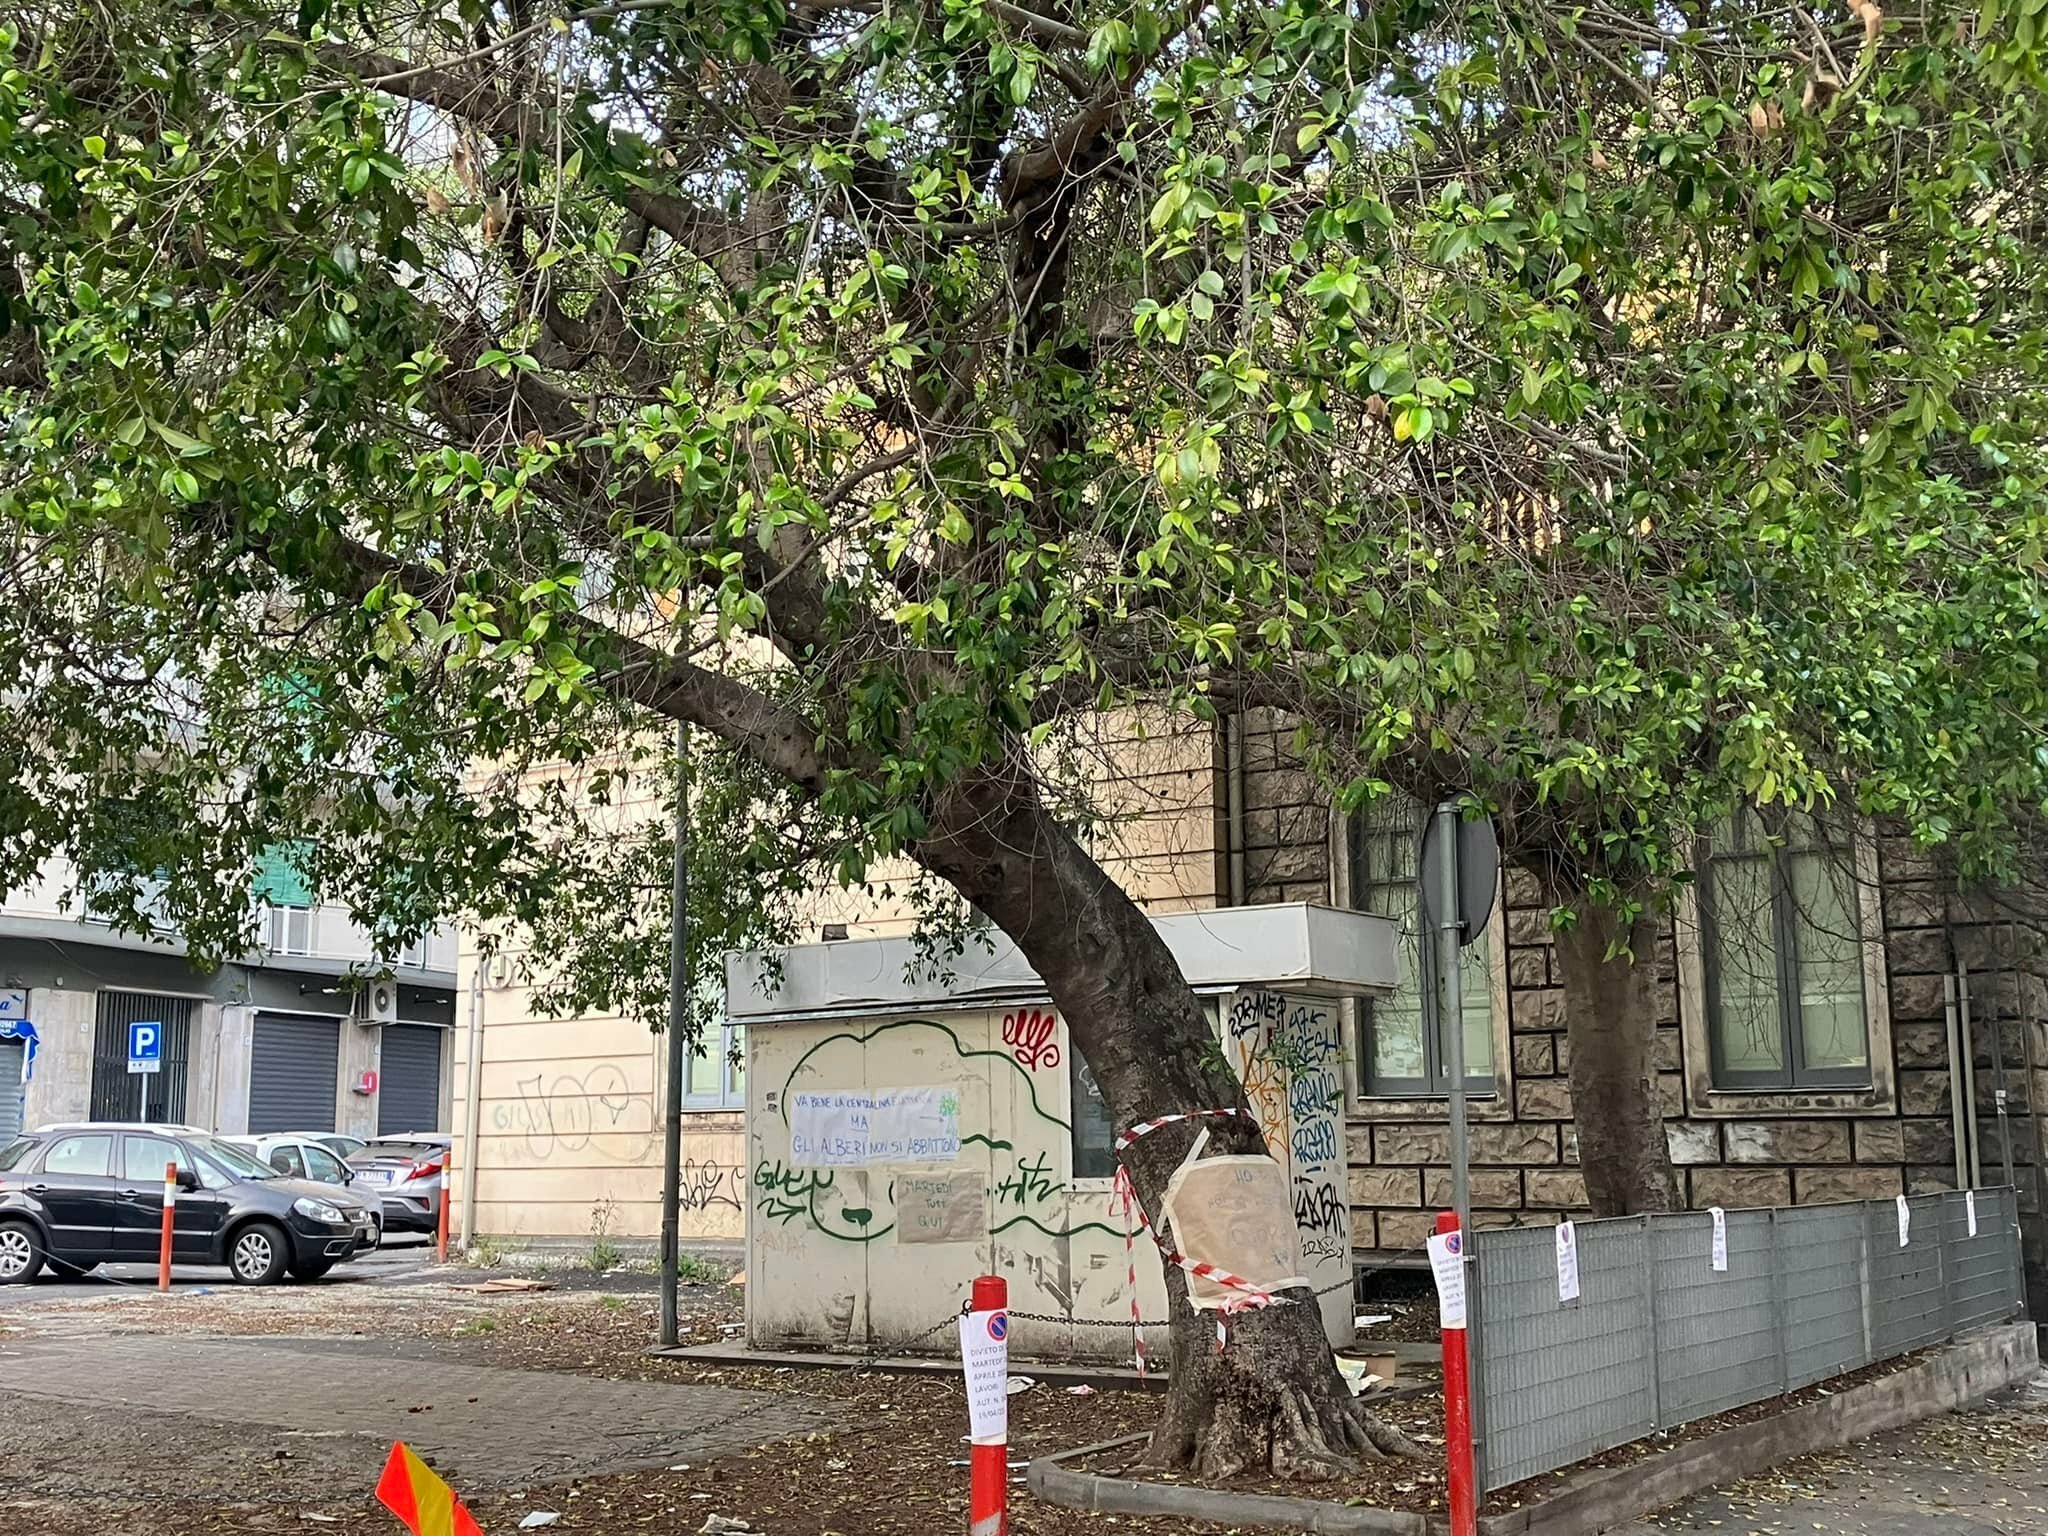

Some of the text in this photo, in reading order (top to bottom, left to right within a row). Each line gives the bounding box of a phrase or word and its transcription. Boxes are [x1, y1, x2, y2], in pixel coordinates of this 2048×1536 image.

[135, 1027, 155, 1056] P
[793, 1095, 808, 1107] VA
[810, 1096, 831, 1108] BENE
[835, 1096, 845, 1108] LA
[851, 1115, 868, 1130] MA
[793, 1135, 961, 1157] GLI ALBERI NON SI ABBATTONO
[918, 1215, 944, 1229] QUI
